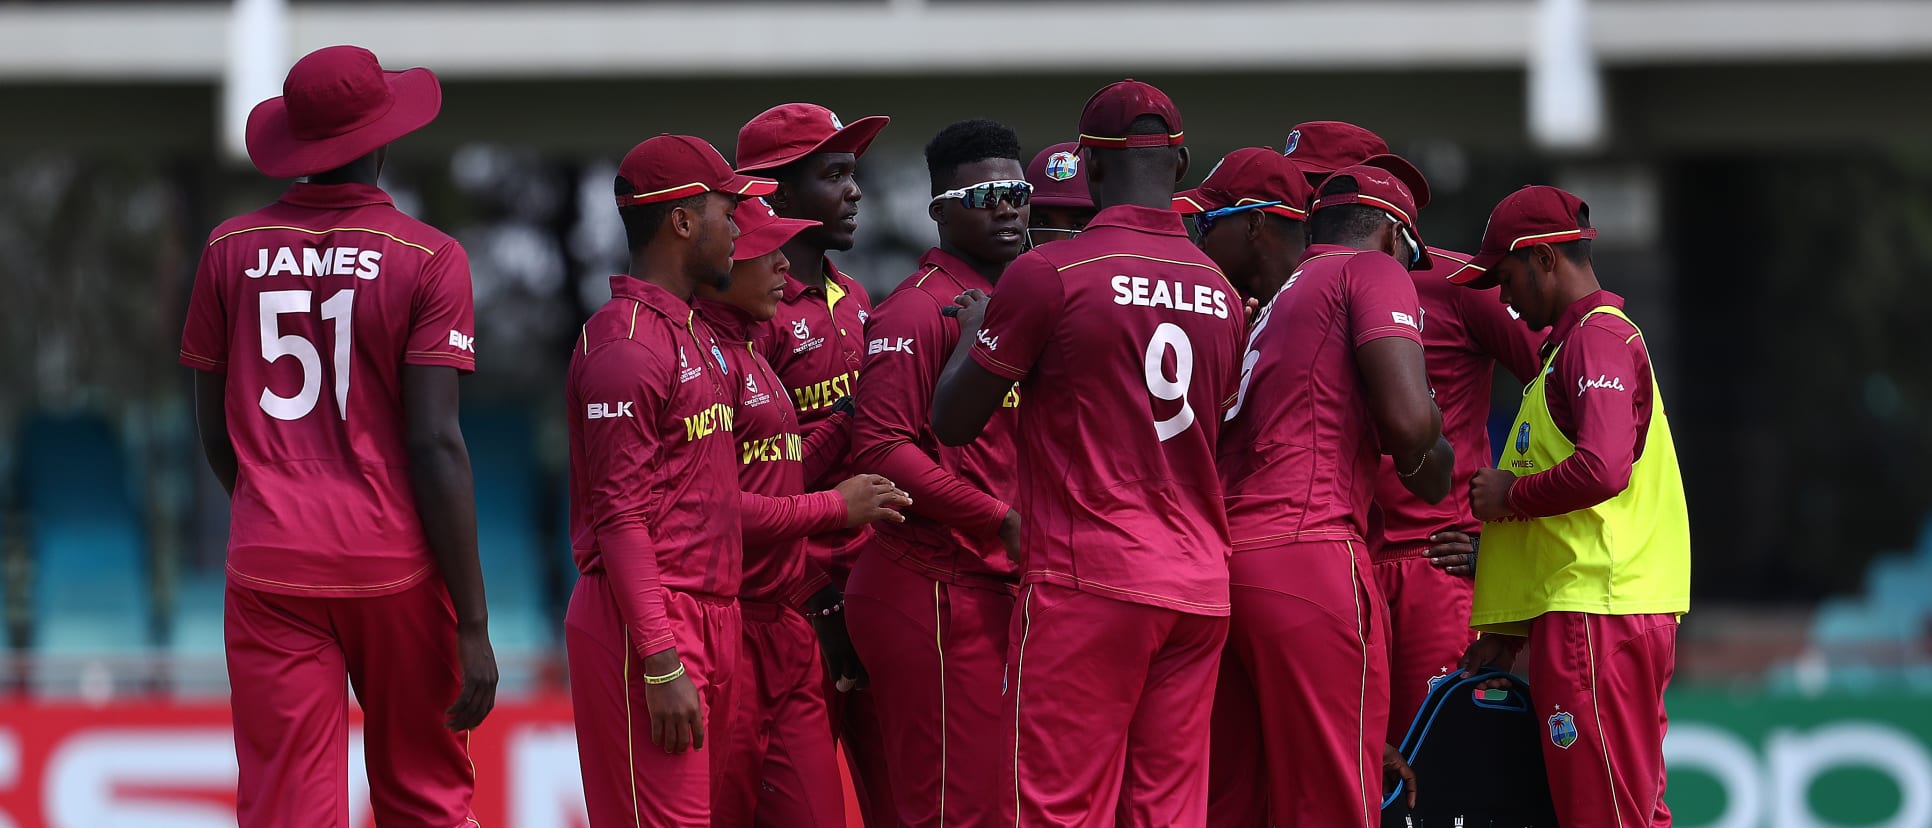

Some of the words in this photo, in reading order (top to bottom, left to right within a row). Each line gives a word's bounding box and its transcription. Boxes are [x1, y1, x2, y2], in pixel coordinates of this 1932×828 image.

[244, 246, 383, 281] JAMES
[1110, 274, 1229, 320] SEALES
[1391, 312, 1419, 330] BL
[259, 288, 355, 422] 51
[448, 329, 476, 354] BLK
[868, 337, 914, 355] BLK
[795, 372, 851, 411] WEST
[1144, 322, 1196, 442] 9
[587, 401, 635, 419] BLK
